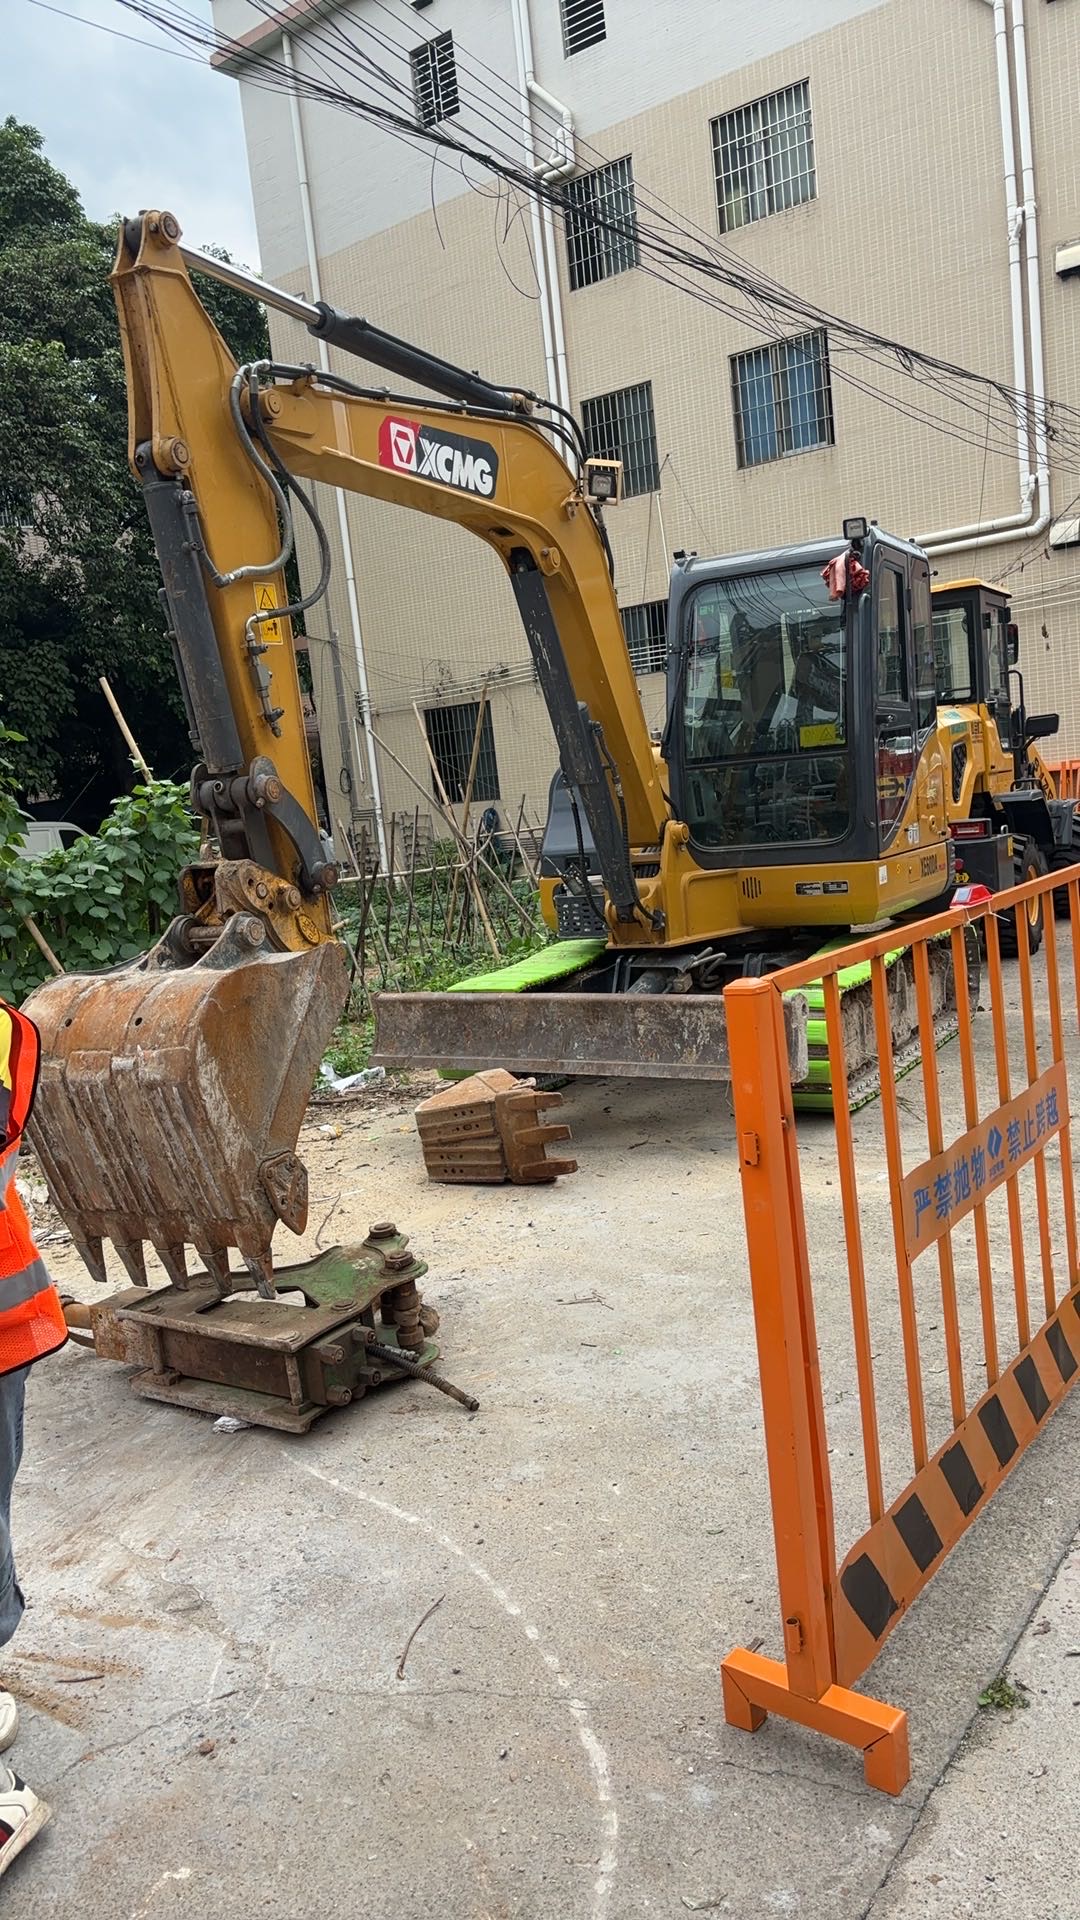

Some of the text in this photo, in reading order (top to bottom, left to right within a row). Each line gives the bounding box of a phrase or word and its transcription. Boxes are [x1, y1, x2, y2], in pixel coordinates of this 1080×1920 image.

[418, 437, 494, 496] XCMG
[914, 1087, 1059, 1238] 严禁抛物 禁止跨越
